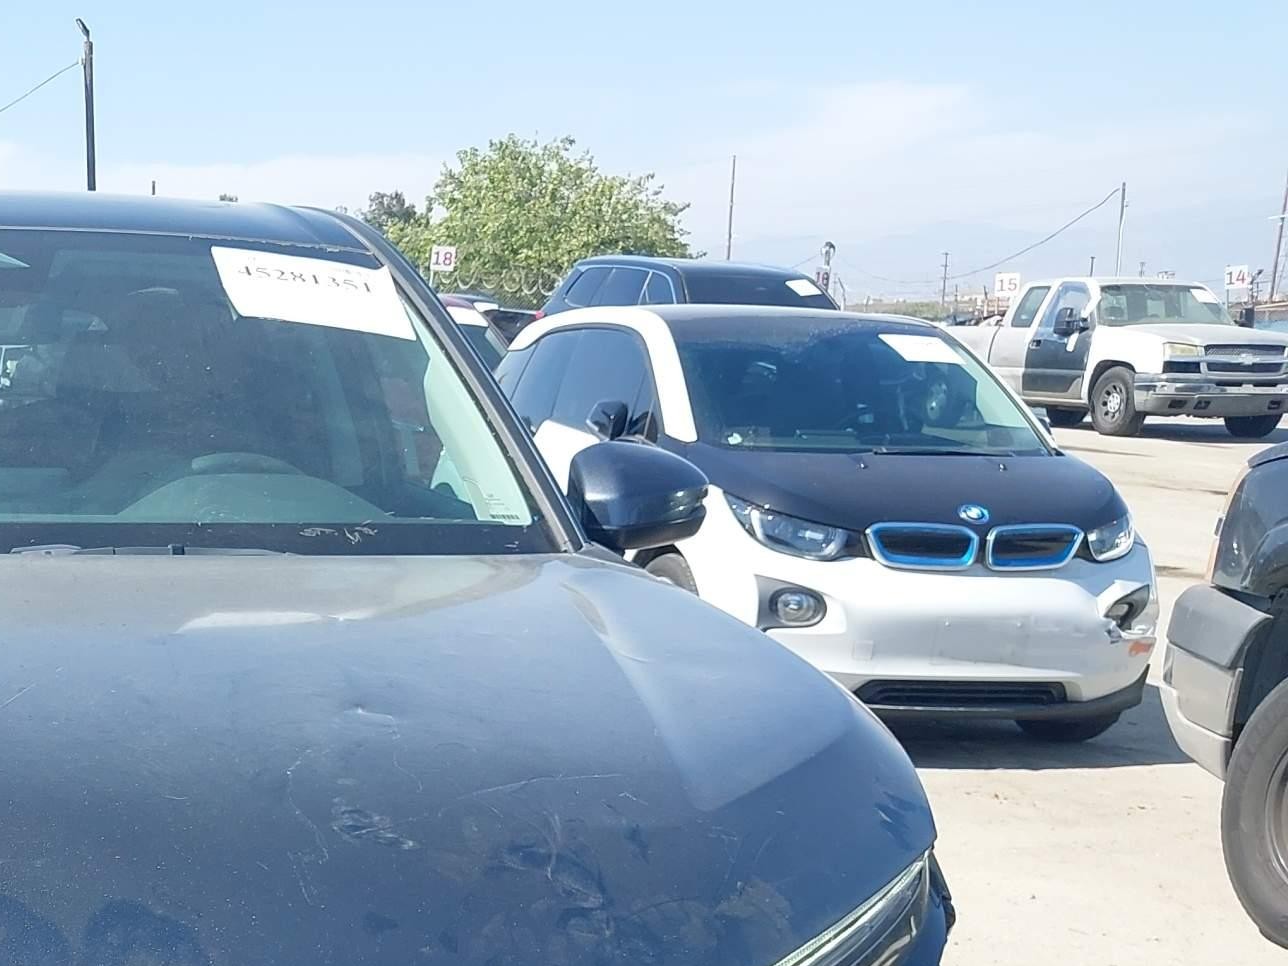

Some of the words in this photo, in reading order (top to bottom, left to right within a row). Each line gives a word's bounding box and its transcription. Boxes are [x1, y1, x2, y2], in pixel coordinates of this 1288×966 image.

[433, 251, 453, 266] 18
[997, 277, 1018, 292] 15
[1226, 269, 1247, 286] 14
